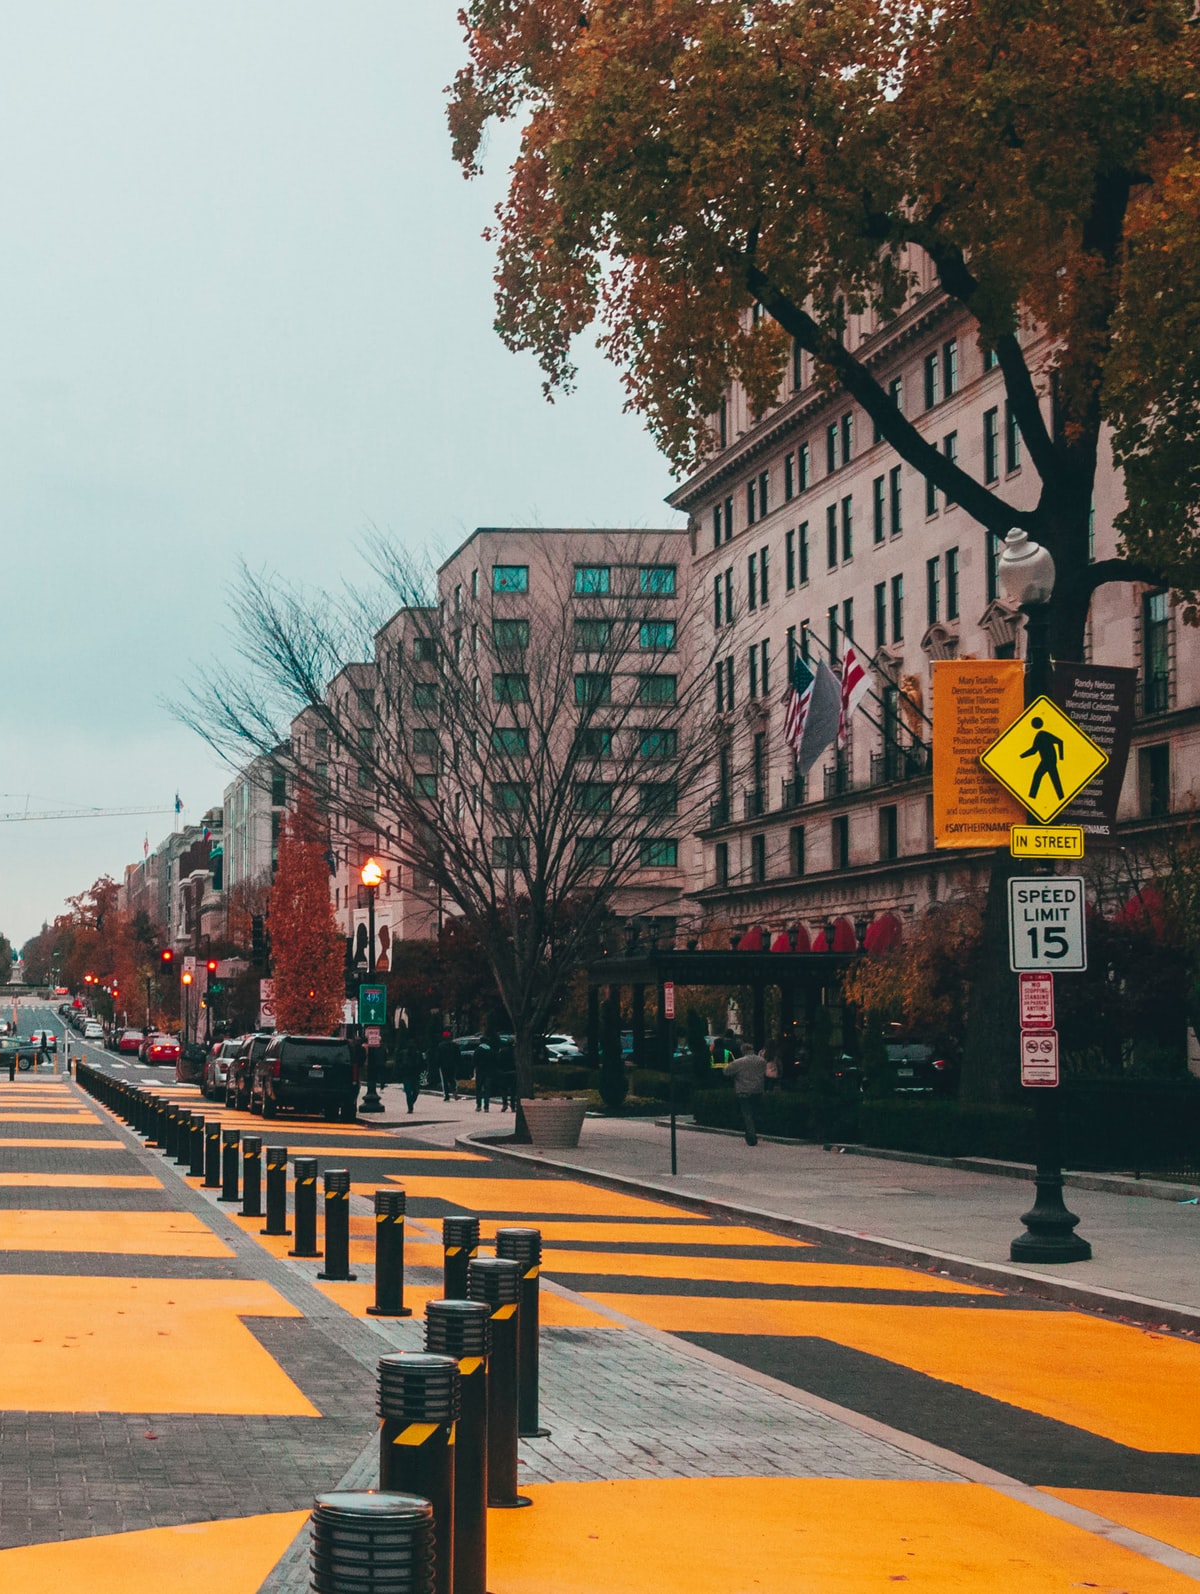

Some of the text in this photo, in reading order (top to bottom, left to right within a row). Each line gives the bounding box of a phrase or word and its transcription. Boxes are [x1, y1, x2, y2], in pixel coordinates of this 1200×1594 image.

[958, 675, 974, 686] Mary
[1074, 678, 1116, 690] Randy Nelson
[951, 687, 983, 695] Demarcus
[1100, 691, 1115, 701] Scott
[957, 696, 975, 705] Willie
[975, 706, 999, 714] Thomas
[1065, 700, 1120, 712] Wendell Celestine
[980, 716, 999, 724] Smith
[1070, 711, 1112, 723] David Joseph
[974, 726, 1000, 736] Sterling
[1091, 734, 1114, 744] Perkins
[954, 776, 976, 785] Jordan
[959, 786, 978, 795] Aaron
[981, 796, 1000, 805] Foster
[1016, 835, 1078, 849] IN STREET
[1017, 889, 1077, 903] SPEED
[1023, 907, 1071, 922] LIMIT
[1026, 926, 1069, 960] 15
[366, 993, 379, 1003] 495
